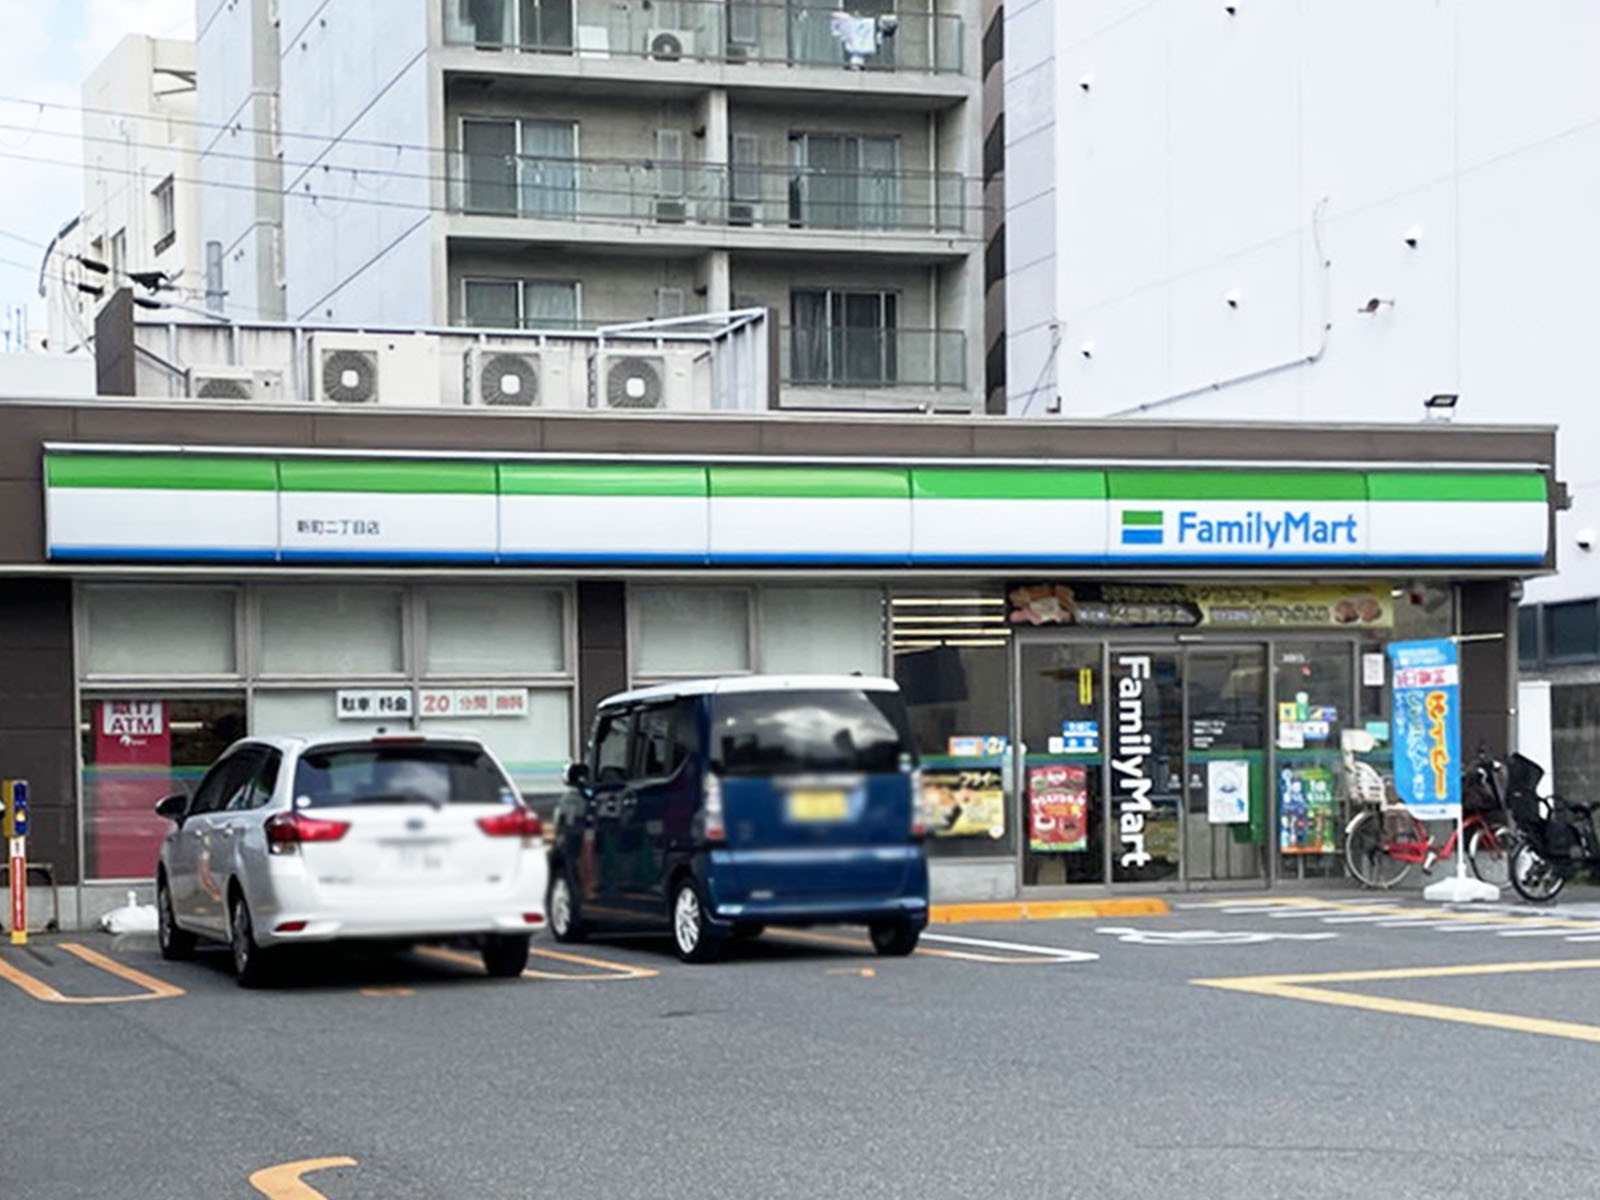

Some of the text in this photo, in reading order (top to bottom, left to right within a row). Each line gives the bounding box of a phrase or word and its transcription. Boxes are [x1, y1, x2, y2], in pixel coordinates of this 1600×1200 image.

[1178, 511, 1357, 549] FamilyMart
[424, 695, 450, 713] 20
[112, 717, 154, 732] ATM
[1111, 656, 1152, 867] FamilyMart
